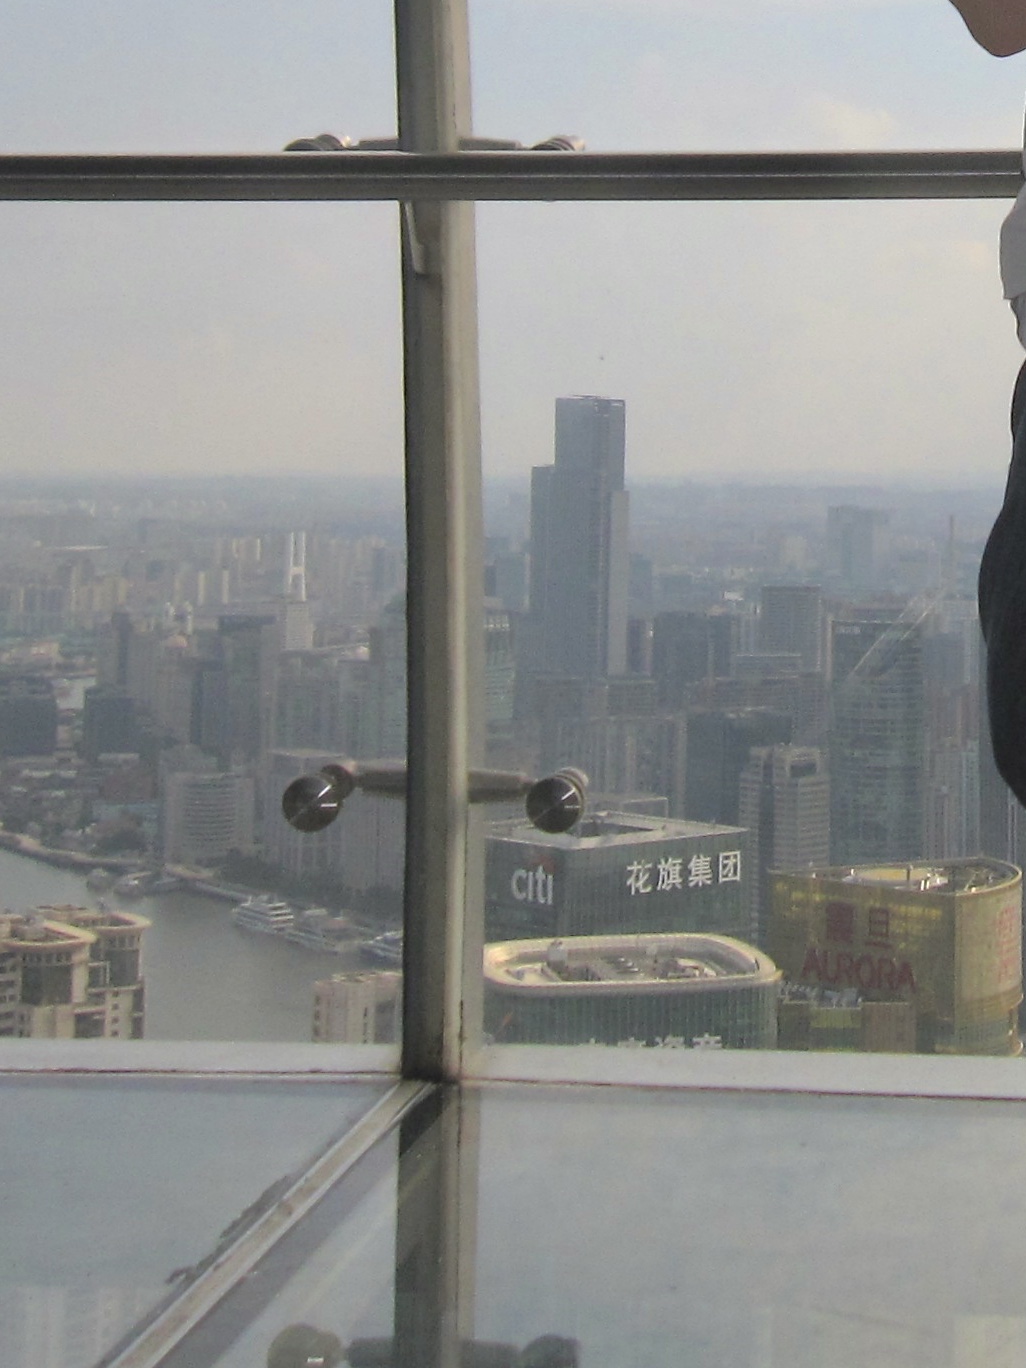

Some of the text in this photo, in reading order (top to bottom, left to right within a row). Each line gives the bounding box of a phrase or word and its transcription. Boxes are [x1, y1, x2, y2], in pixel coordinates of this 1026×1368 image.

[511, 864, 554, 905] citi
[626, 851, 741, 895] 花旗集团
[801, 947, 916, 994] AURORA
